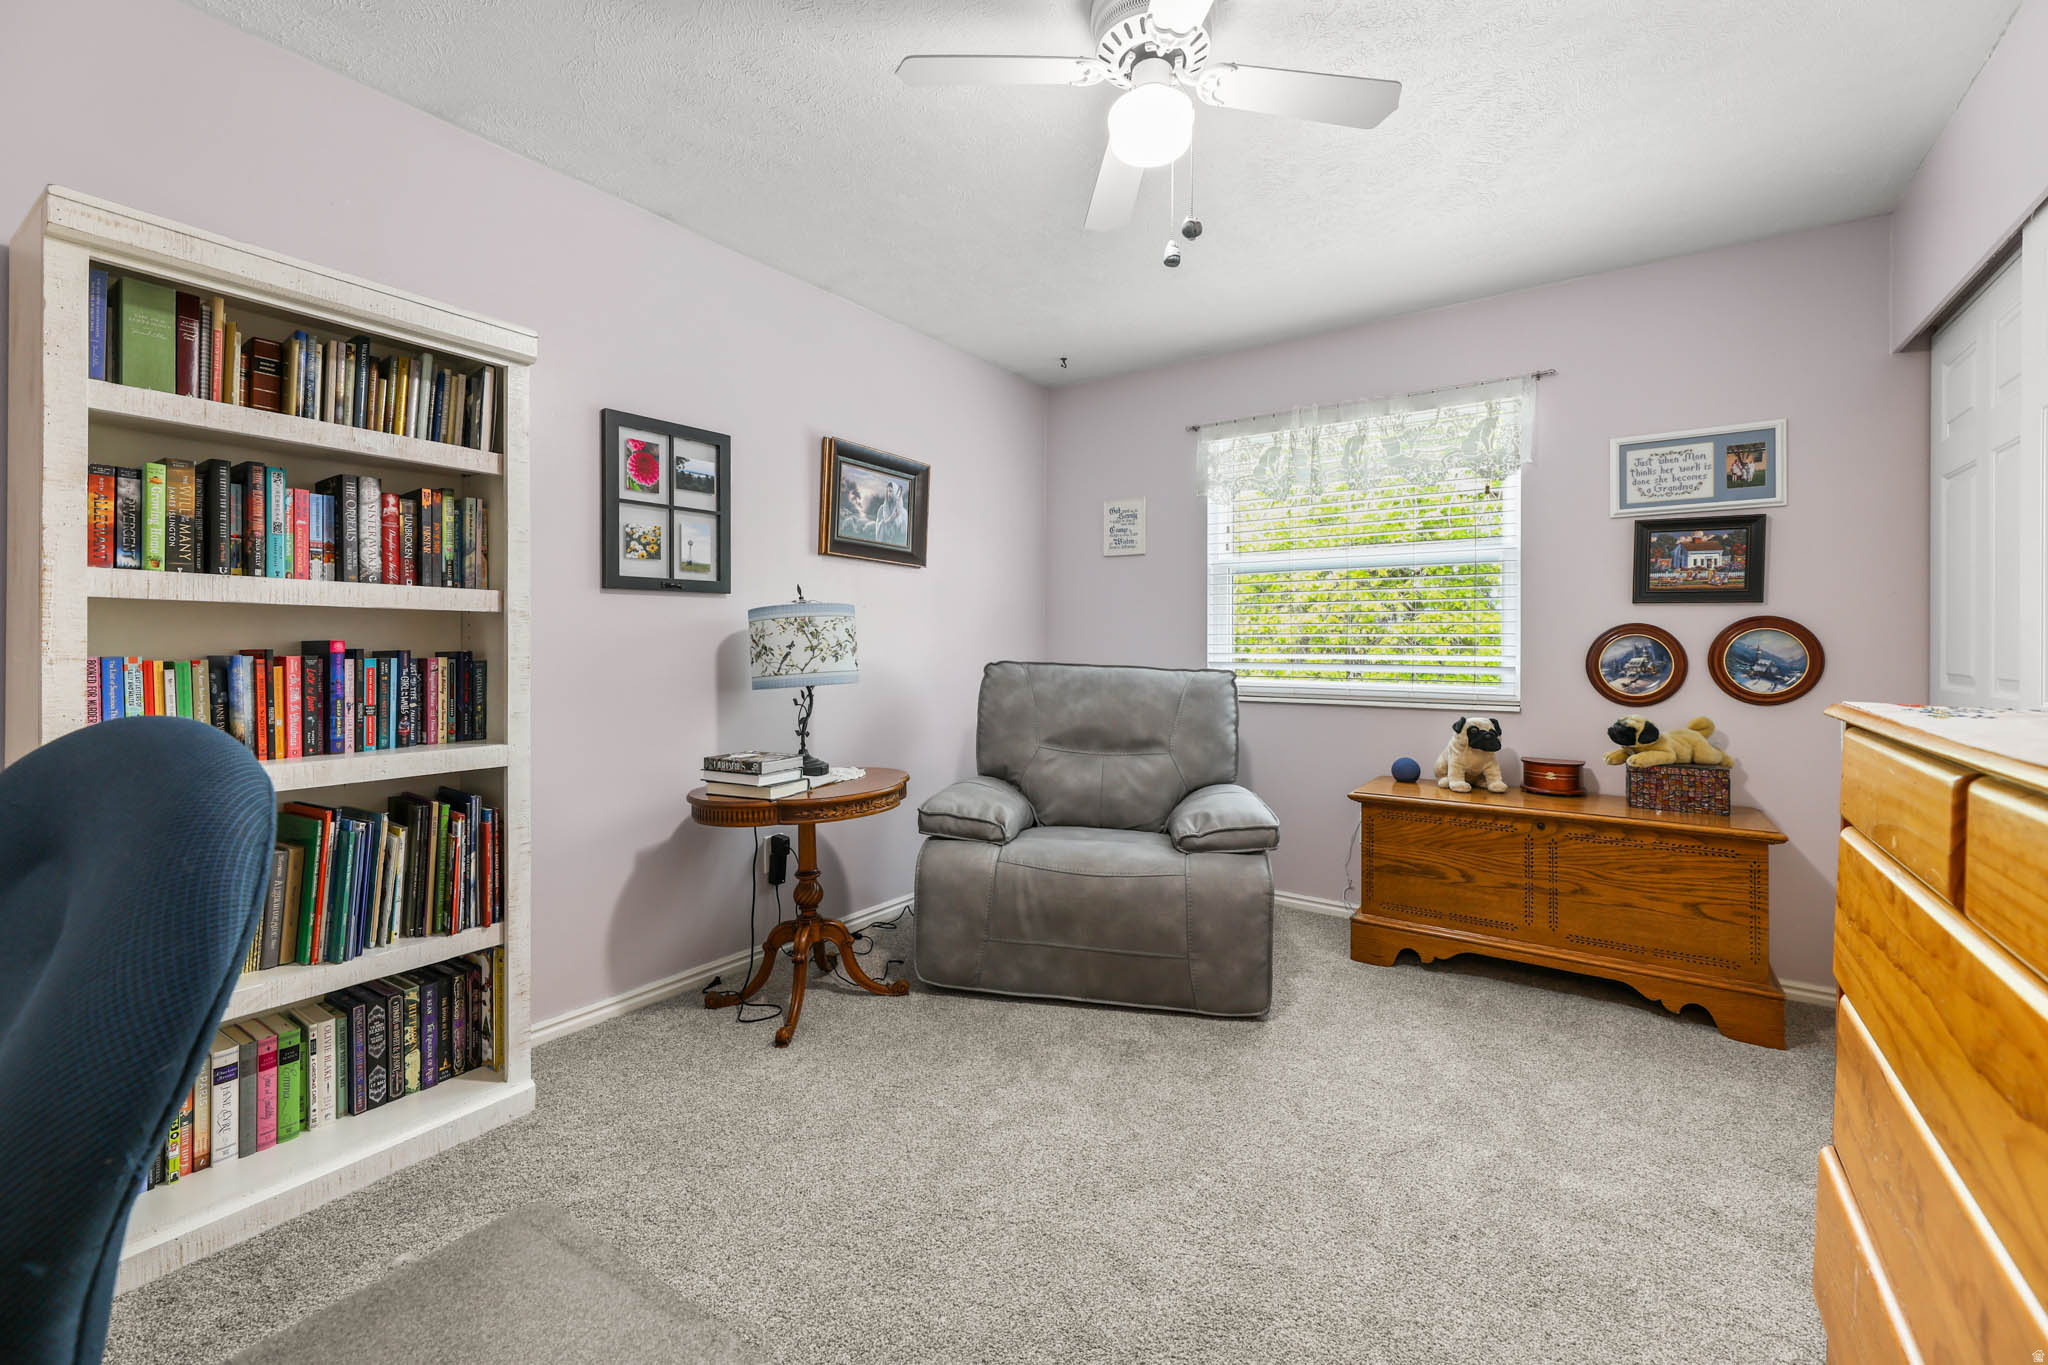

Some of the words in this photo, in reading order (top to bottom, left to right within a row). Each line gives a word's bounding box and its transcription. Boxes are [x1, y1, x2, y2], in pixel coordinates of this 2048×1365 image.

[168, 486, 177, 508] JAMES
[179, 486, 192, 514] WILL
[345, 481, 356, 498] THE
[147, 486, 162, 525] Growing
[93, 491, 109, 561] ALLEGIANT
[122, 497, 137, 560] DIVERGENT
[168, 509, 177, 547] ISLINGTON
[344, 499, 357, 542] ORDEALS
[367, 504, 377, 537] SISTER
[150, 527, 163, 553] Home
[178, 523, 192, 561] MANY
[403, 516, 414, 559] UNBROKEN
[87, 659, 96, 684] BOOKED
[410, 663, 418, 676] JUST
[87, 686, 97, 698] FOR
[401, 676, 410, 691] GIRL
[87, 699, 98, 724] MURDER
[215, 704, 225, 721] JANE
[323, 1025, 333, 1053] OLIVIE
[426, 1034, 434, 1057] KINGDOM
[323, 1055, 332, 1081] BLAKE
[199, 1075, 208, 1106] PARIS
[221, 1084, 233, 1108] JANE
